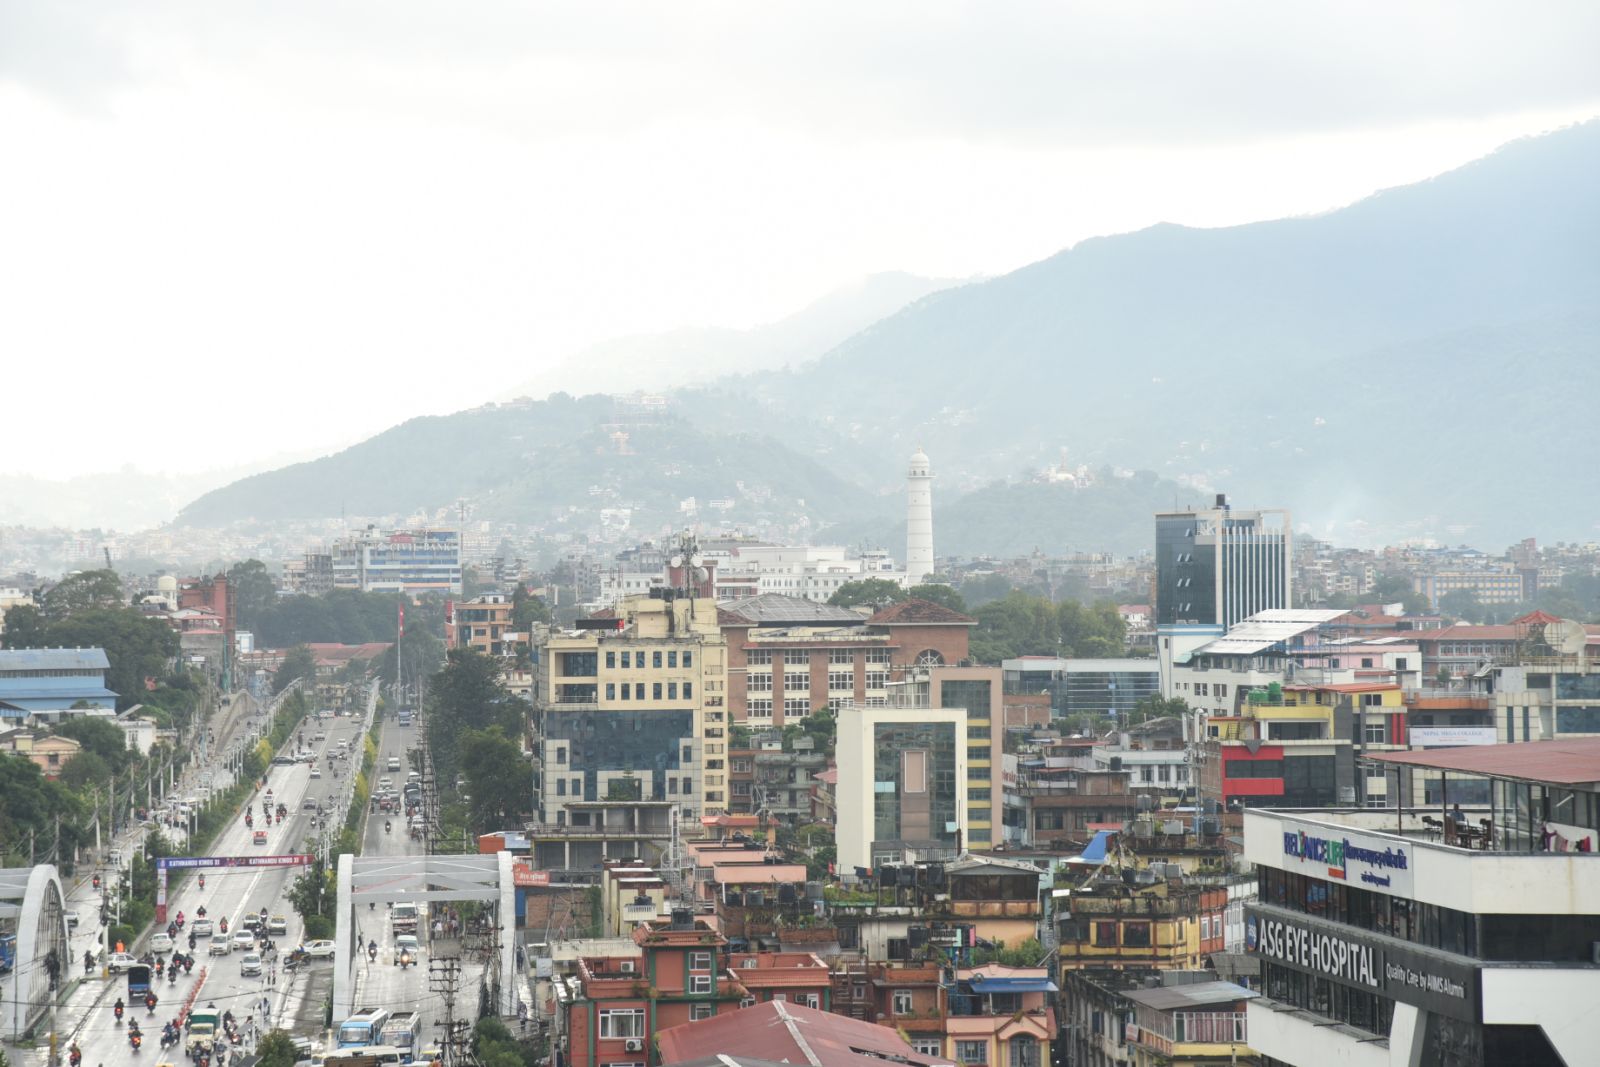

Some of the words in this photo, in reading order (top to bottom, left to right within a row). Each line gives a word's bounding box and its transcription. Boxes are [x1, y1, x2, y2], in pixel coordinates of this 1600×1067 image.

[424, 543, 450, 551] BANK
[1260, 918, 1283, 959] ASG
[1286, 925, 1309, 967] EYE
[1310, 932, 1378, 987] HOSPITAL
[1386, 962, 1405, 985] Quality
[1407, 968, 1418, 987] Care
[1419, 970, 1426, 992] by
[1444, 977, 1465, 999] Alumni
